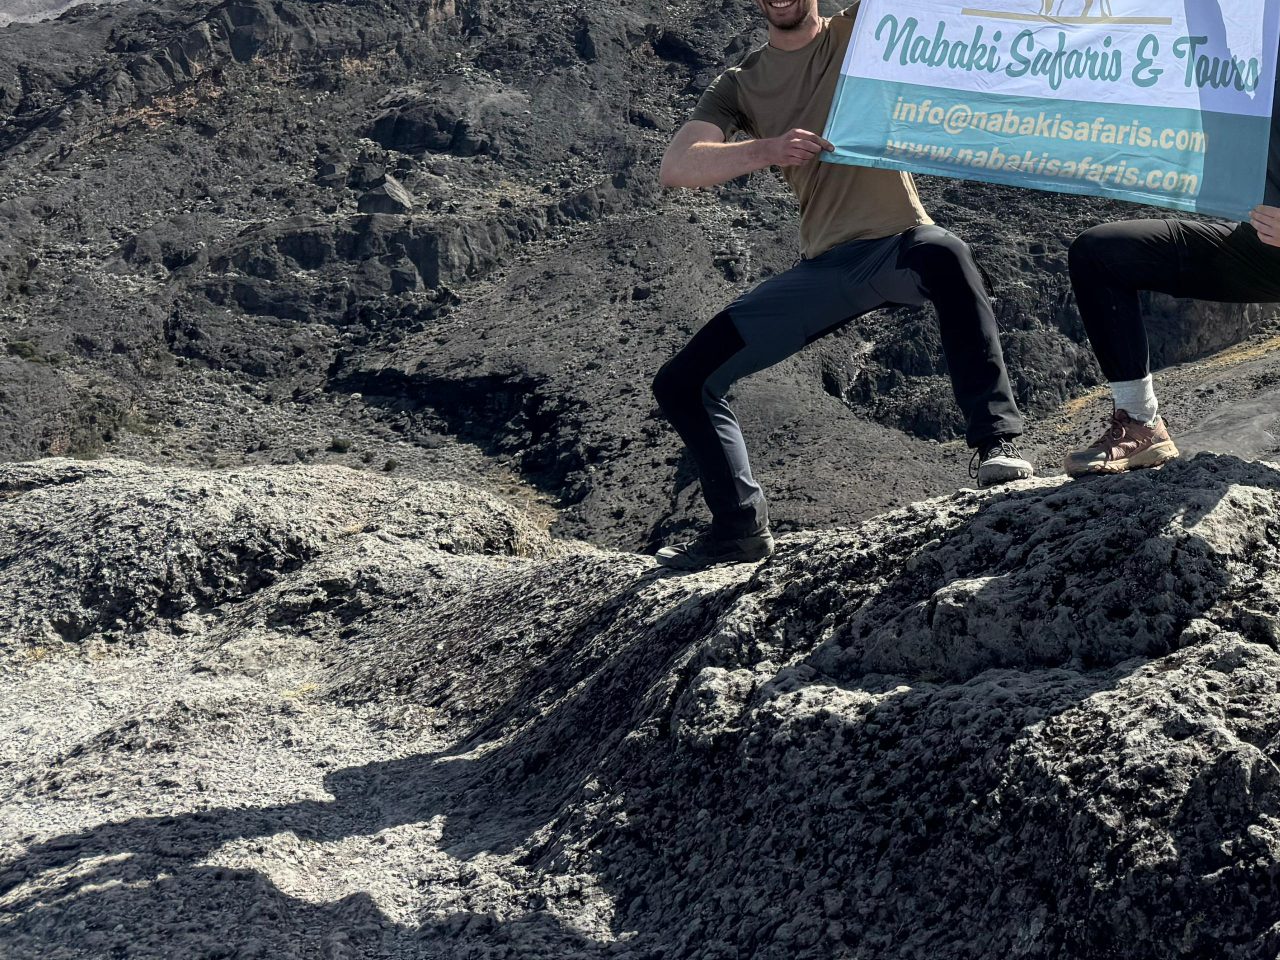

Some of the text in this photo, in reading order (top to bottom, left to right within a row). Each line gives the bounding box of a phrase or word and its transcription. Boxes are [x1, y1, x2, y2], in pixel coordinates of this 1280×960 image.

[875, 14, 1260, 92] Nabaki Safaris & Tours
[892, 96, 1209, 154] info@nabakisafaris.com
